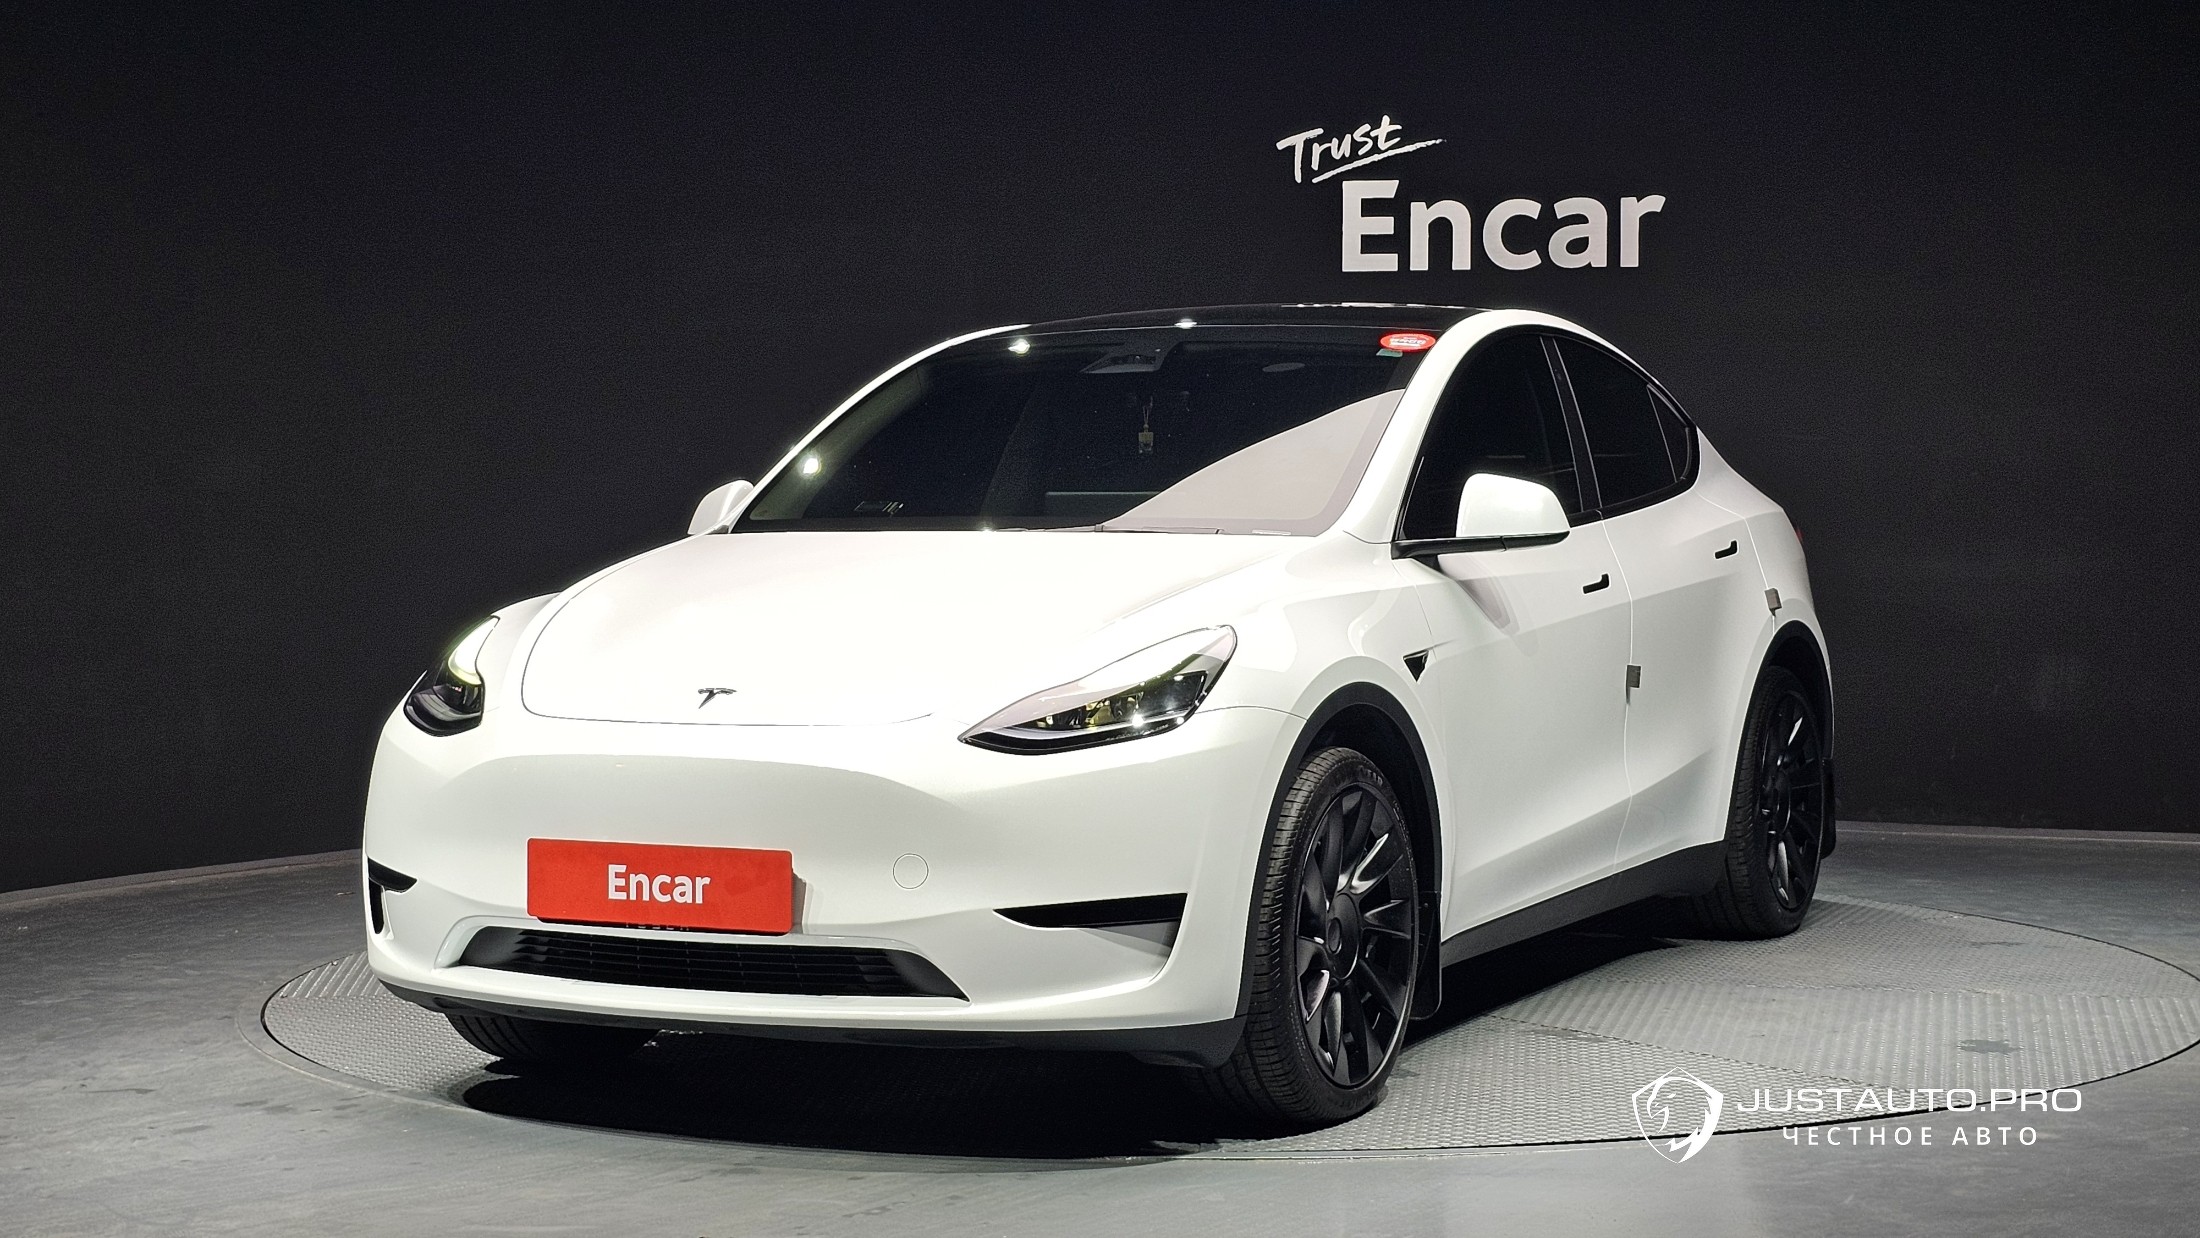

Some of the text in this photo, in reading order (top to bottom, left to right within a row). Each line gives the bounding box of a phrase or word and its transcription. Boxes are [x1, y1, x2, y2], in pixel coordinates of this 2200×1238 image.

[1276, 115, 1402, 184] Trust
[1342, 180, 1666, 272] Encar
[608, 864, 711, 904] Encar
